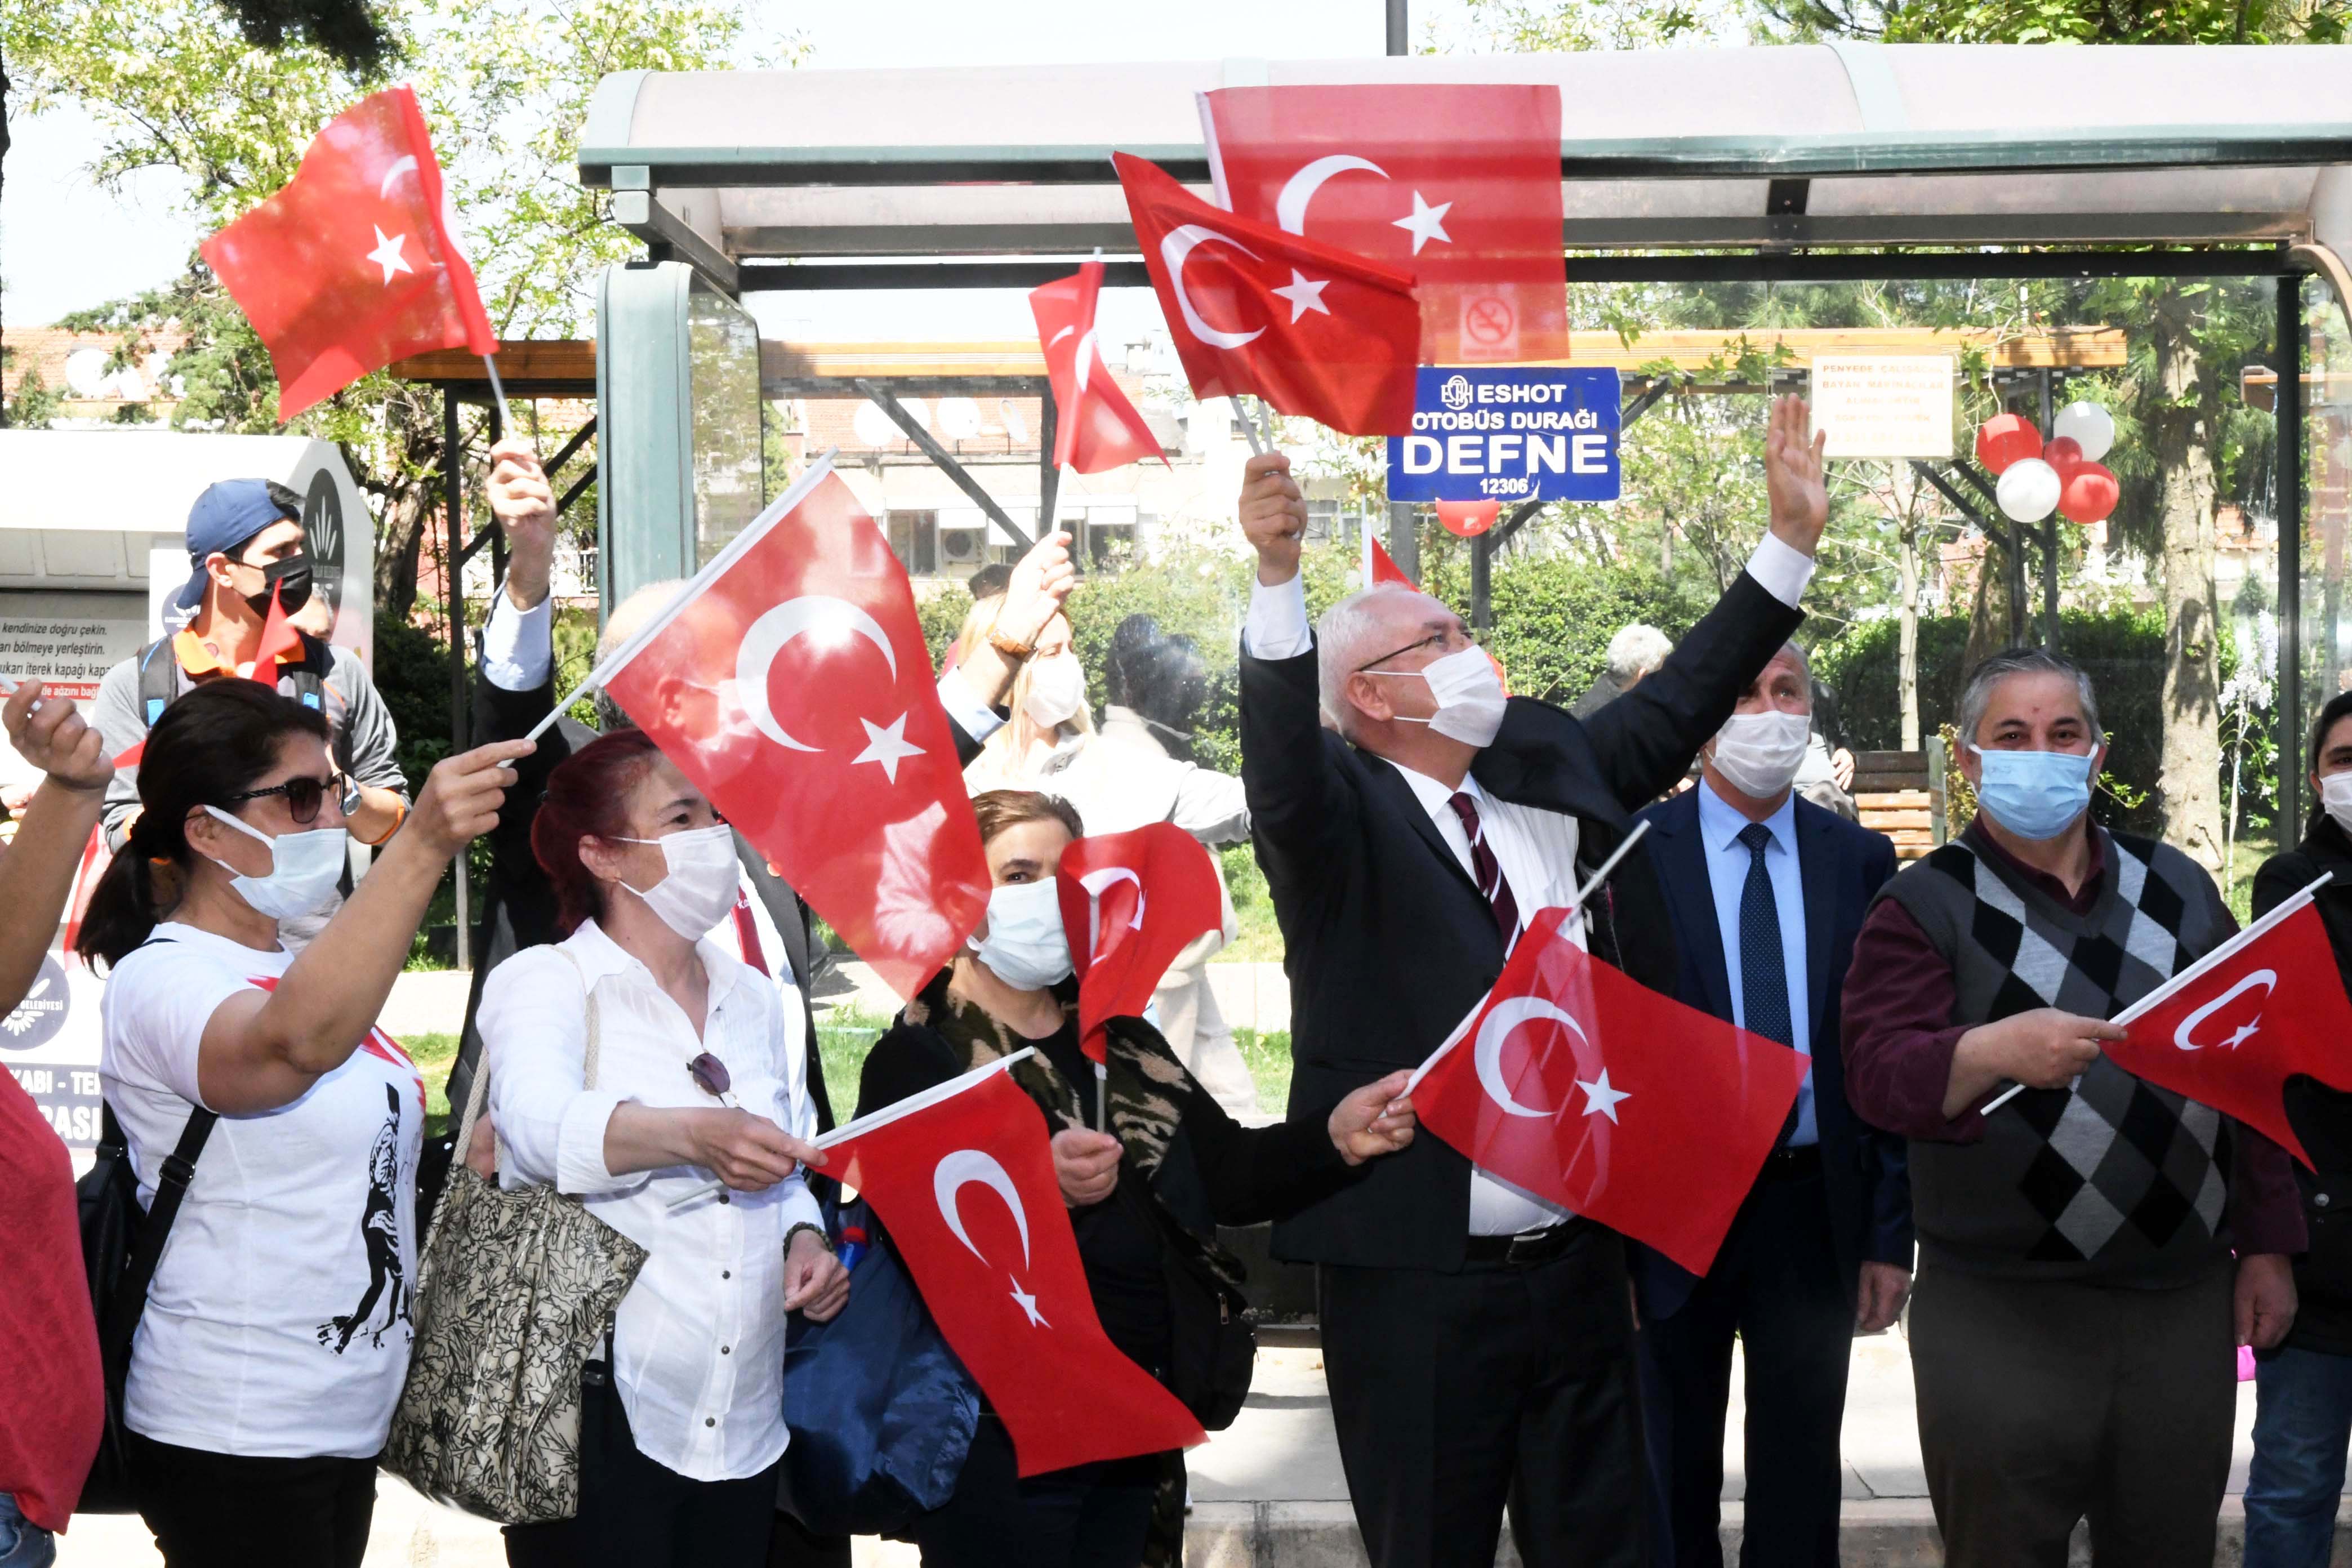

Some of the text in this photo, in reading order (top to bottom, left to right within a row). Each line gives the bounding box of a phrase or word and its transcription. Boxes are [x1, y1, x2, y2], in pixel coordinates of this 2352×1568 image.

[1477, 384, 1566, 403] ESHOT
[1412, 409, 1597, 430] OTOBÜS DURAĞI
[1403, 435, 1609, 475] DEFNE
[1480, 478, 1528, 495] 12306
[2, 622, 107, 637] kendinize doğru çekin.
[14, 641, 53, 656] bölmeye
[56, 642, 105, 657] yerleştirin.
[26, 662, 51, 675] iterek
[56, 663, 86, 679] kapağı
